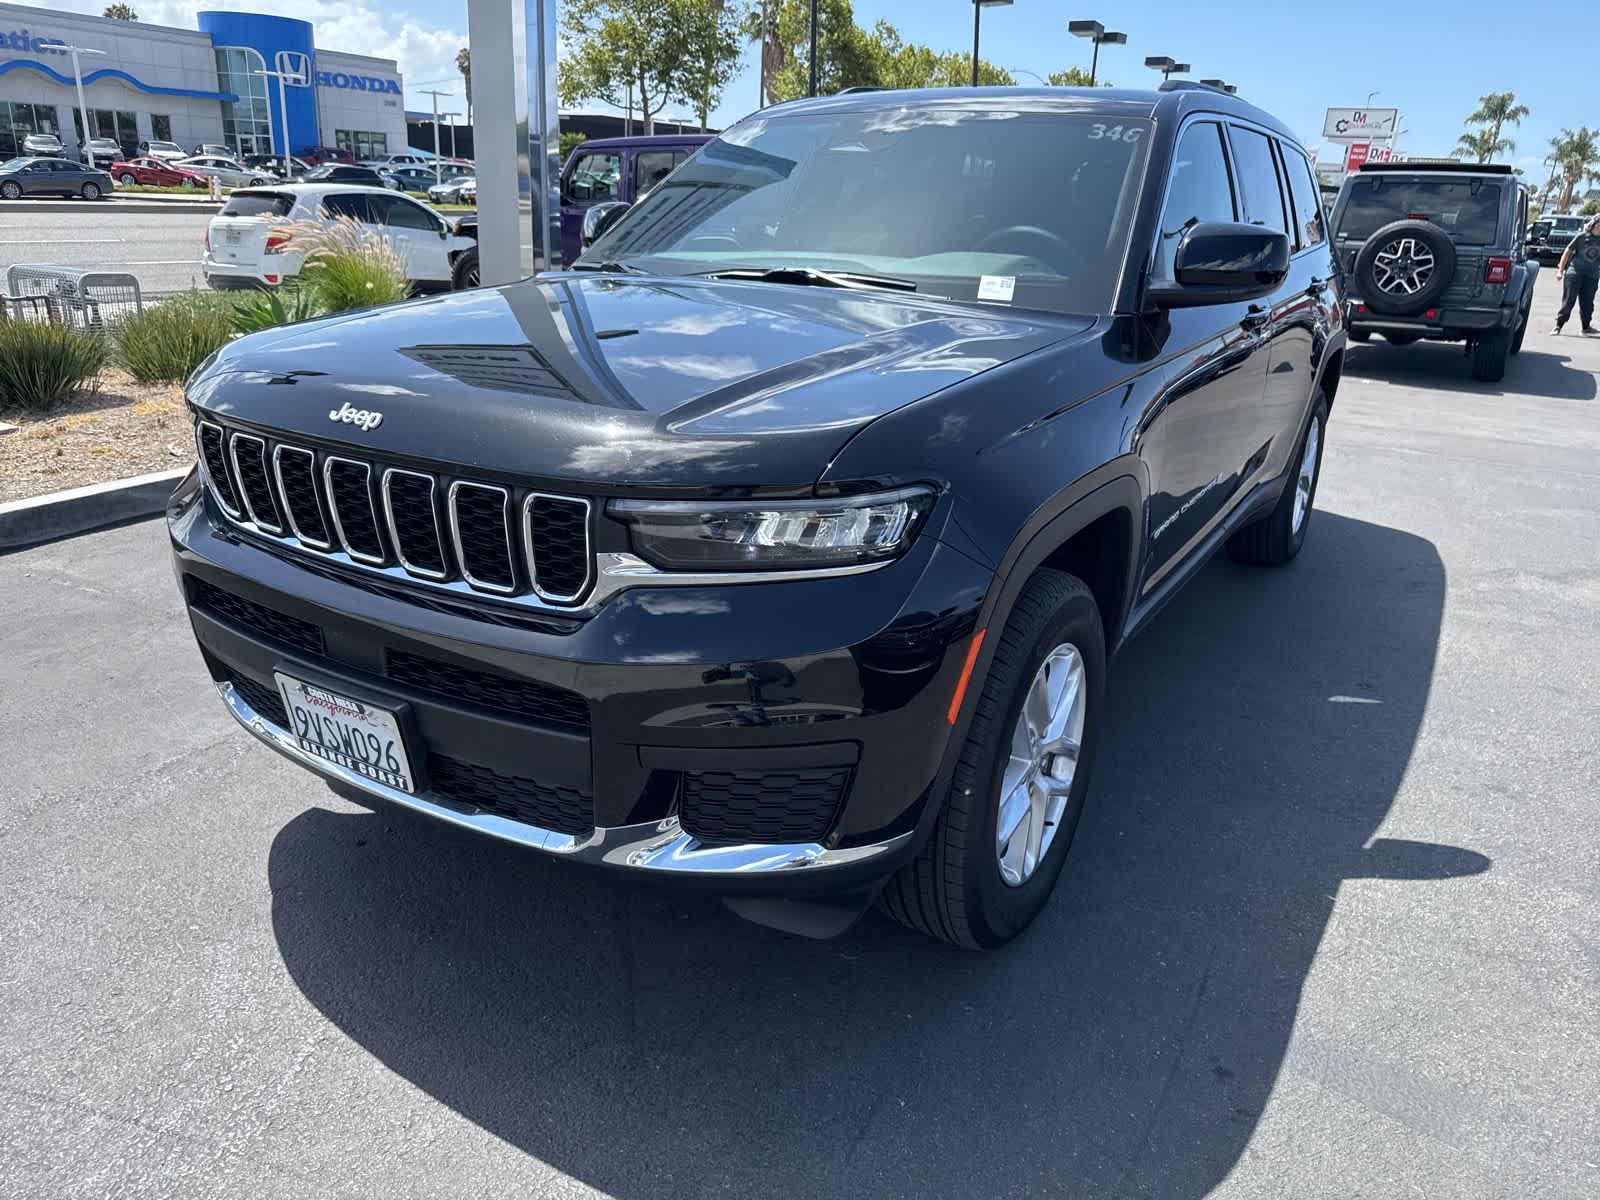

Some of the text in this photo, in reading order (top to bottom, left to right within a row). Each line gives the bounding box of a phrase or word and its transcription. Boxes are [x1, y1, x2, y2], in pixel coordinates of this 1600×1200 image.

[315, 71, 402, 95] HONDA
[1088, 124, 1145, 143] 346
[329, 402, 383, 432] Jeep
[295, 706, 400, 772] 9VSW096
[303, 741, 404, 789] ORANGE COAST
